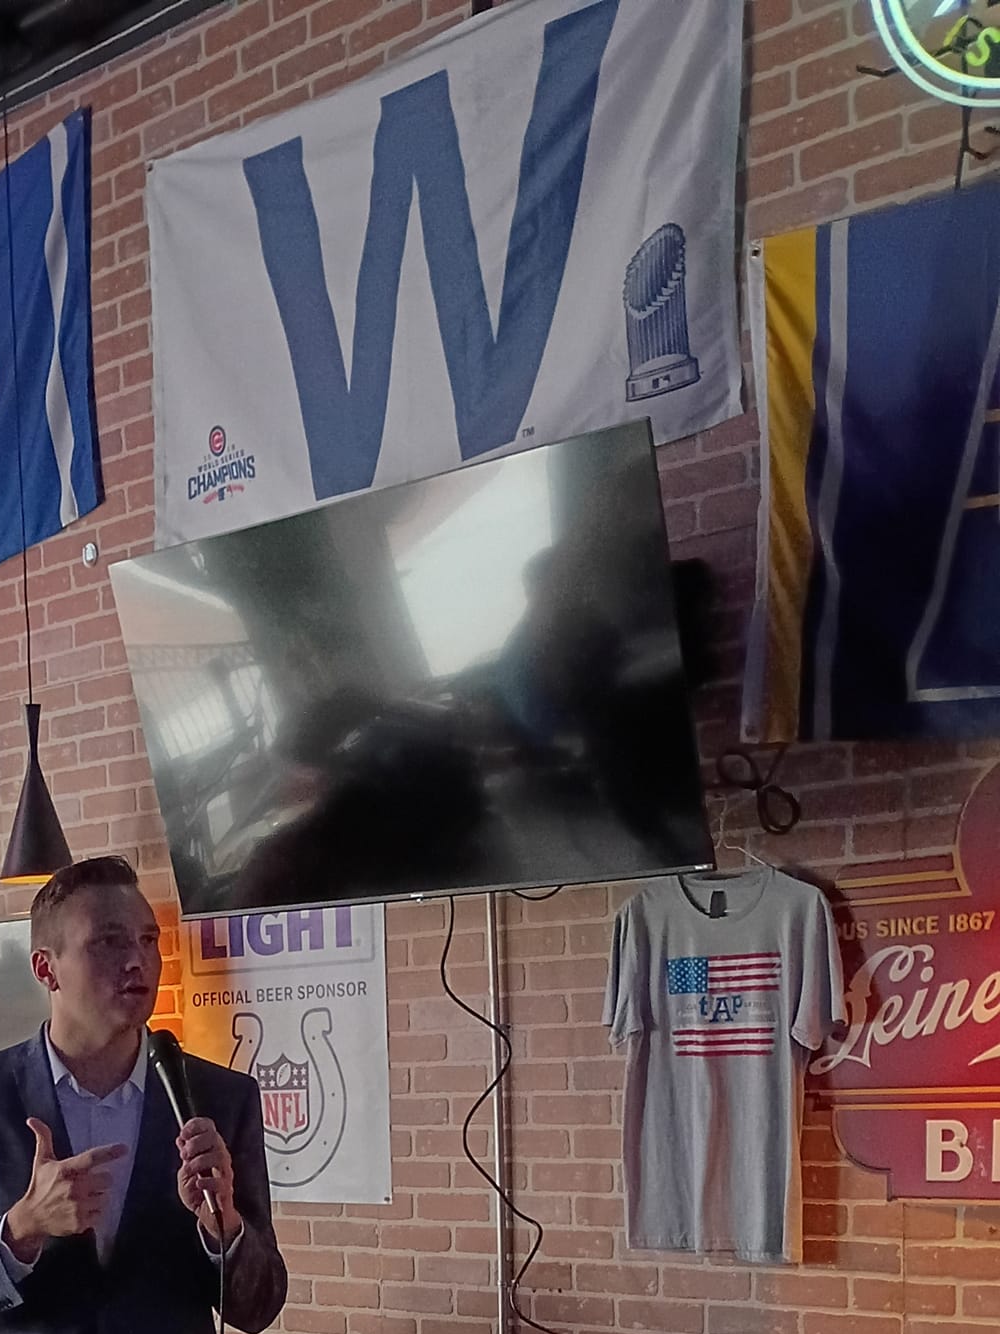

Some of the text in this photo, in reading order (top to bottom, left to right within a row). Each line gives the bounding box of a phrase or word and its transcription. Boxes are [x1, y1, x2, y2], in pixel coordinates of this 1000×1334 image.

[242, 0, 620, 501] W
[187, 455, 256, 500] CHAMPIONS
[876, 915, 940, 938] SINCE
[948, 911, 995, 932] 1867
[192, 980, 368, 1008] OFFICIAL BEER SPONSOR
[263, 1091, 307, 1133] NFL
